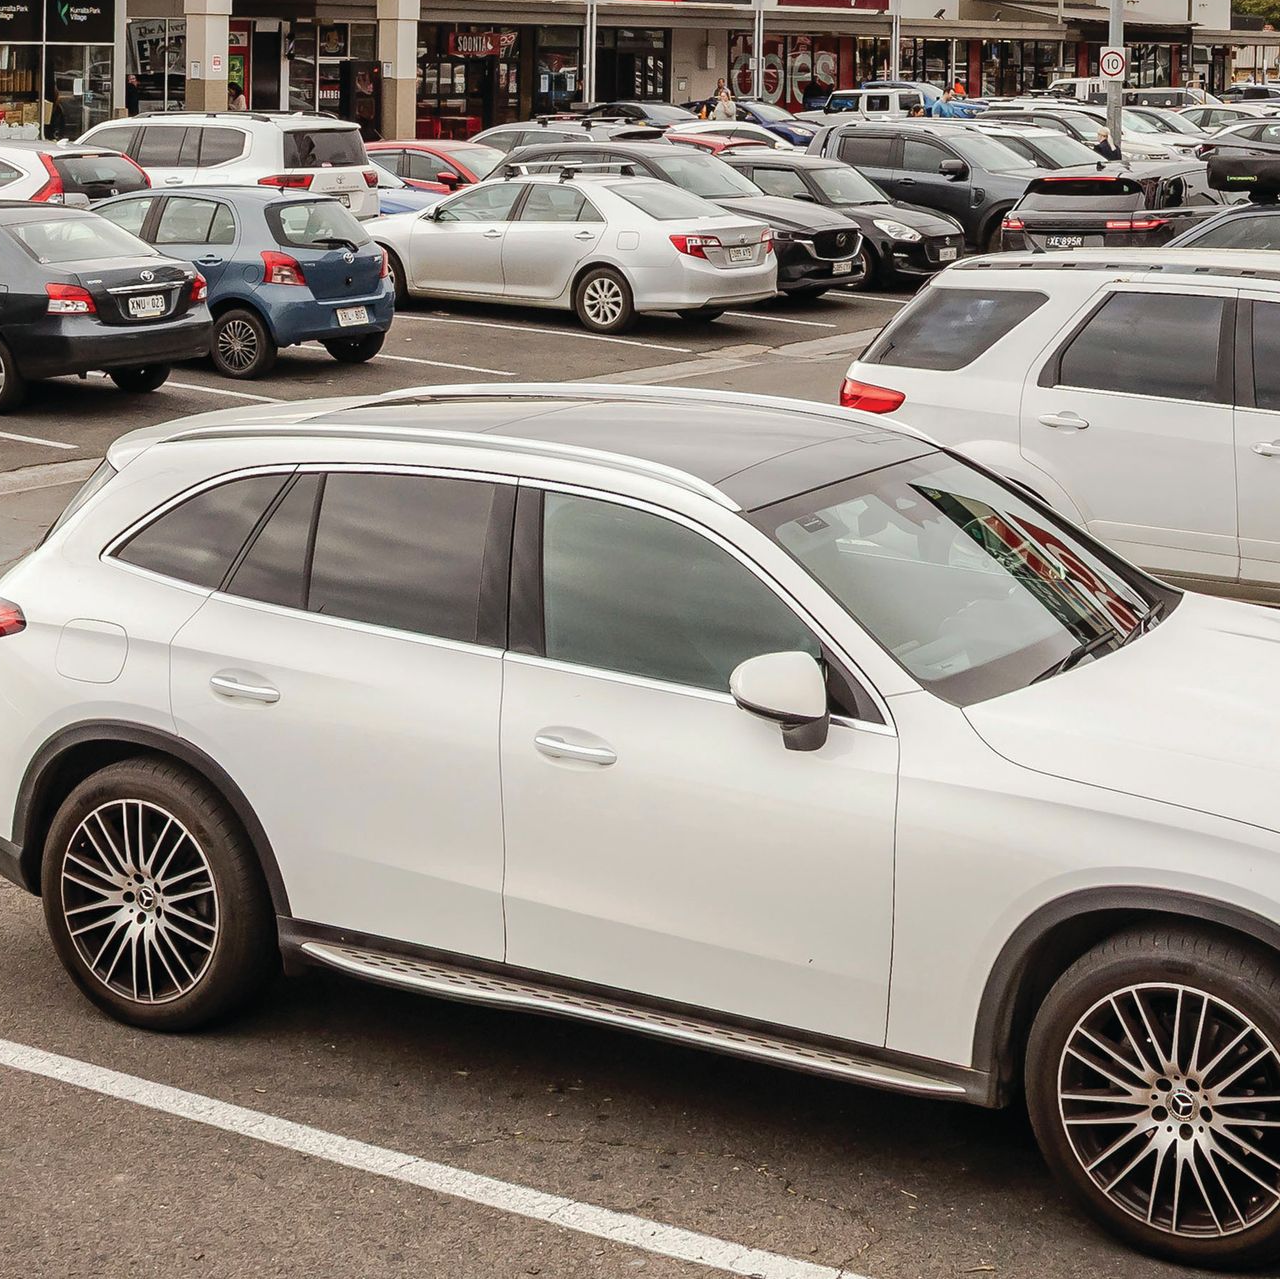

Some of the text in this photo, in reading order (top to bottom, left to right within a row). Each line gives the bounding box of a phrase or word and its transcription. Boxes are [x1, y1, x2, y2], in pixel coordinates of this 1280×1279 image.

[16, 5, 29, 13] Park
[89, 7, 101, 15] Park
[70, 14, 87, 22] Village
[136, 25, 155, 38] The
[457, 35, 487, 52] SOONTA
[1106, 58, 1119, 70] 10
[130, 296, 164, 311] XNU 023
